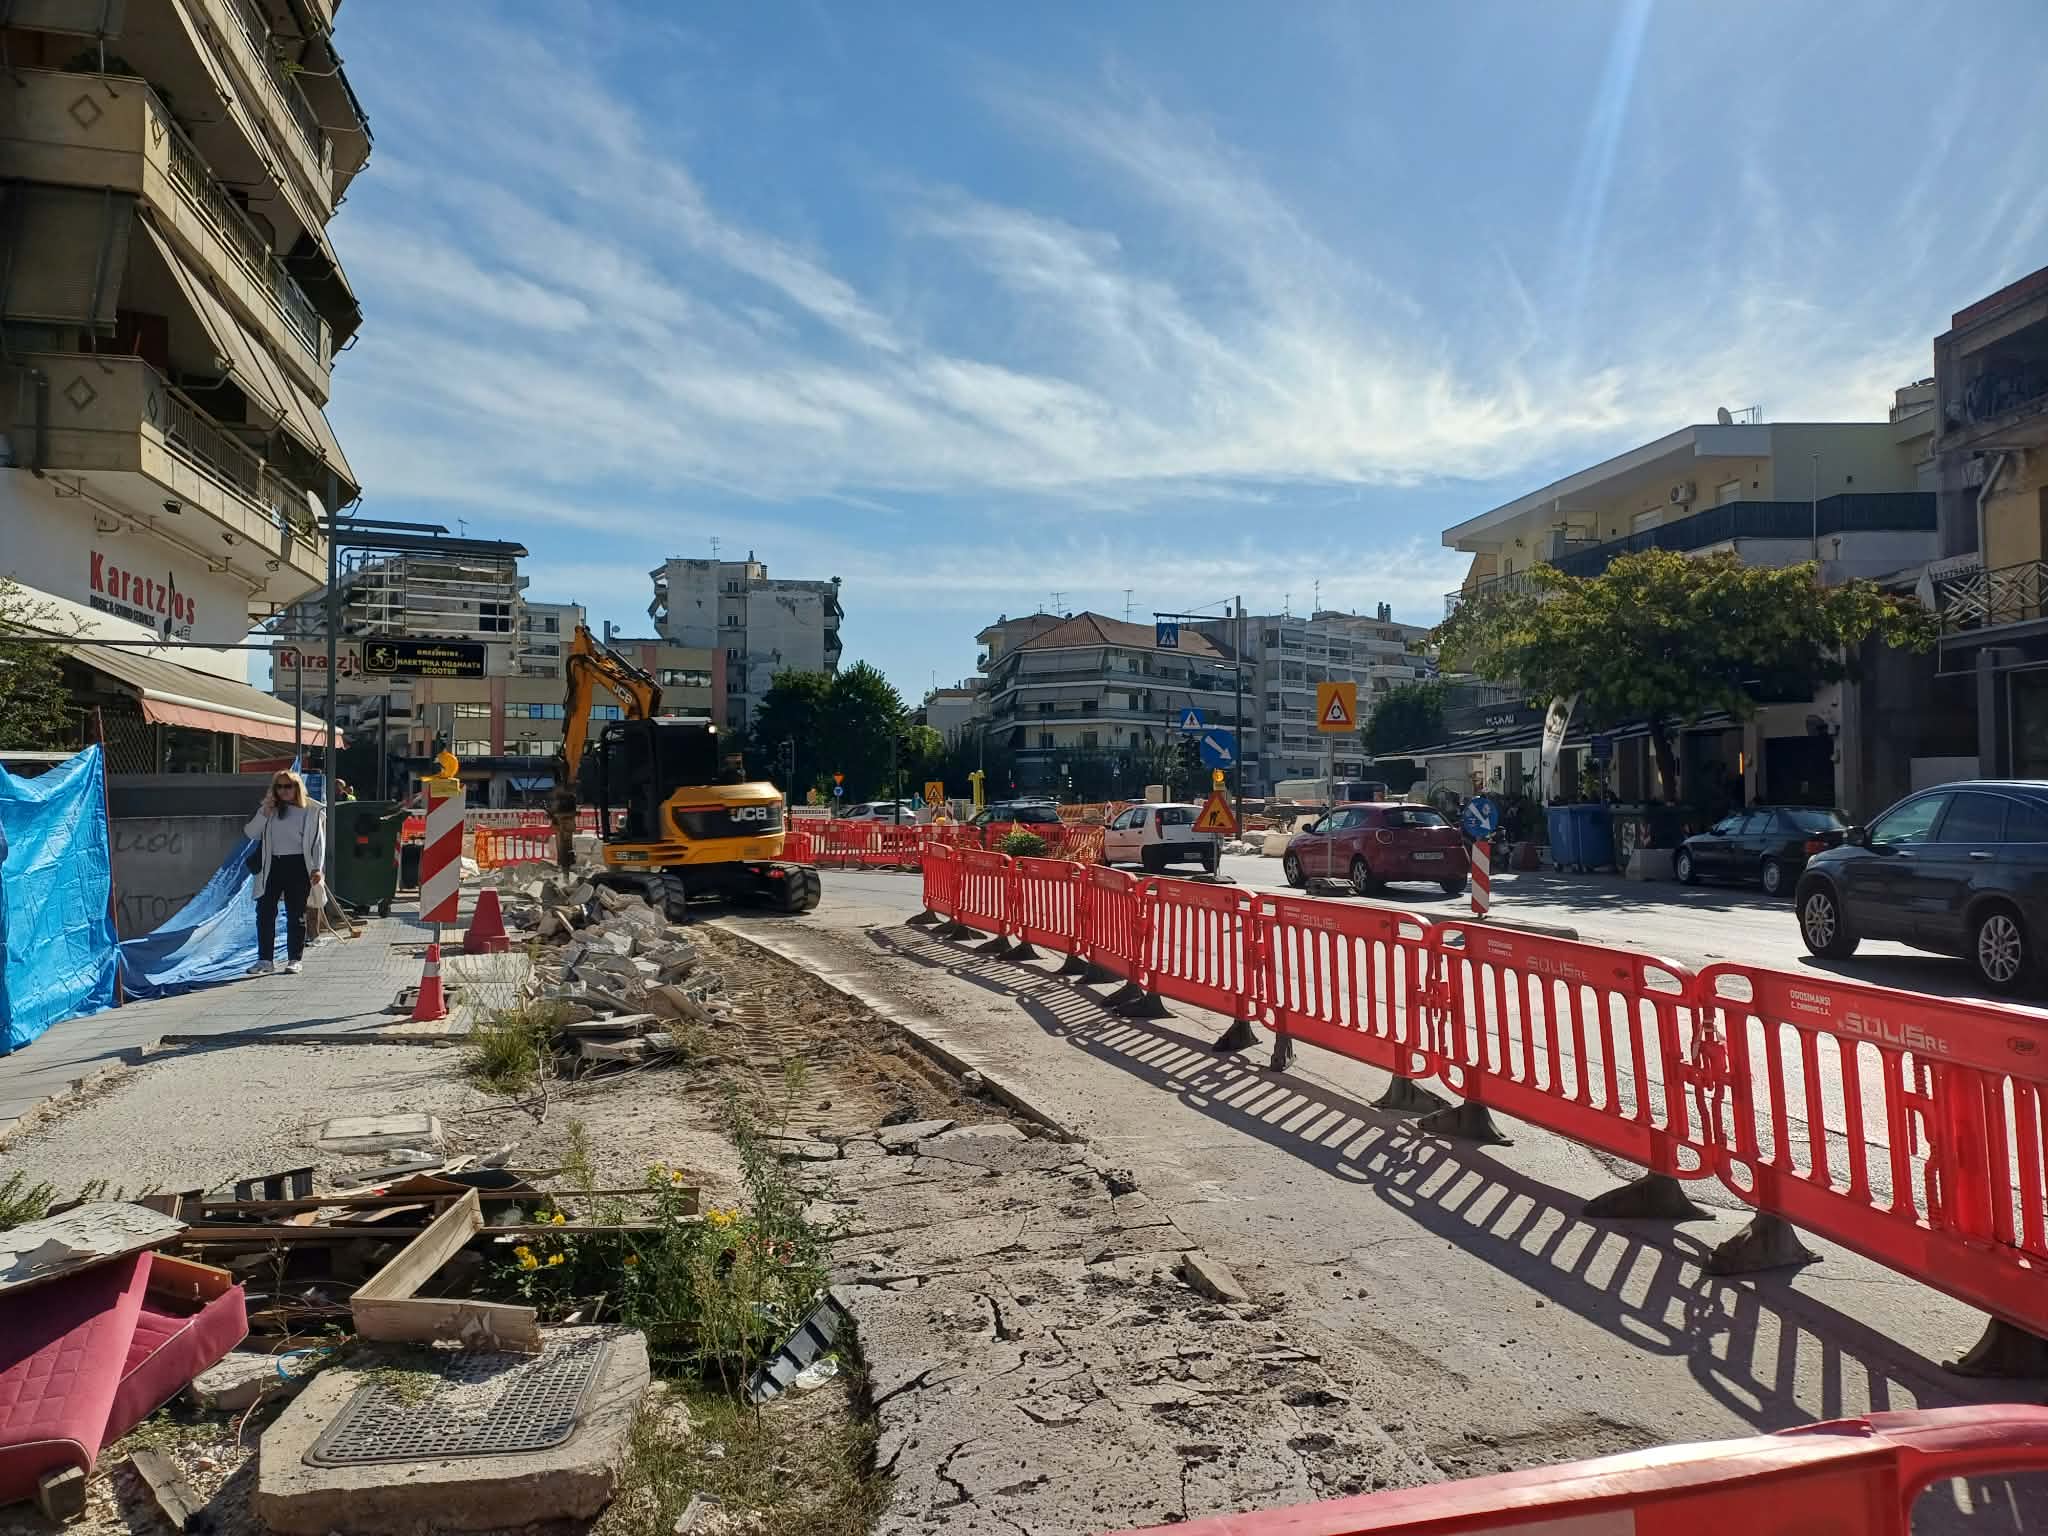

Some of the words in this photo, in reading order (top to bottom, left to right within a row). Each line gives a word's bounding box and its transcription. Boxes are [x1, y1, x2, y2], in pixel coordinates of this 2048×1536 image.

[422, 667, 457, 675] SCOOTER
[612, 683, 633, 704] JCB
[730, 807, 768, 822] JCB
